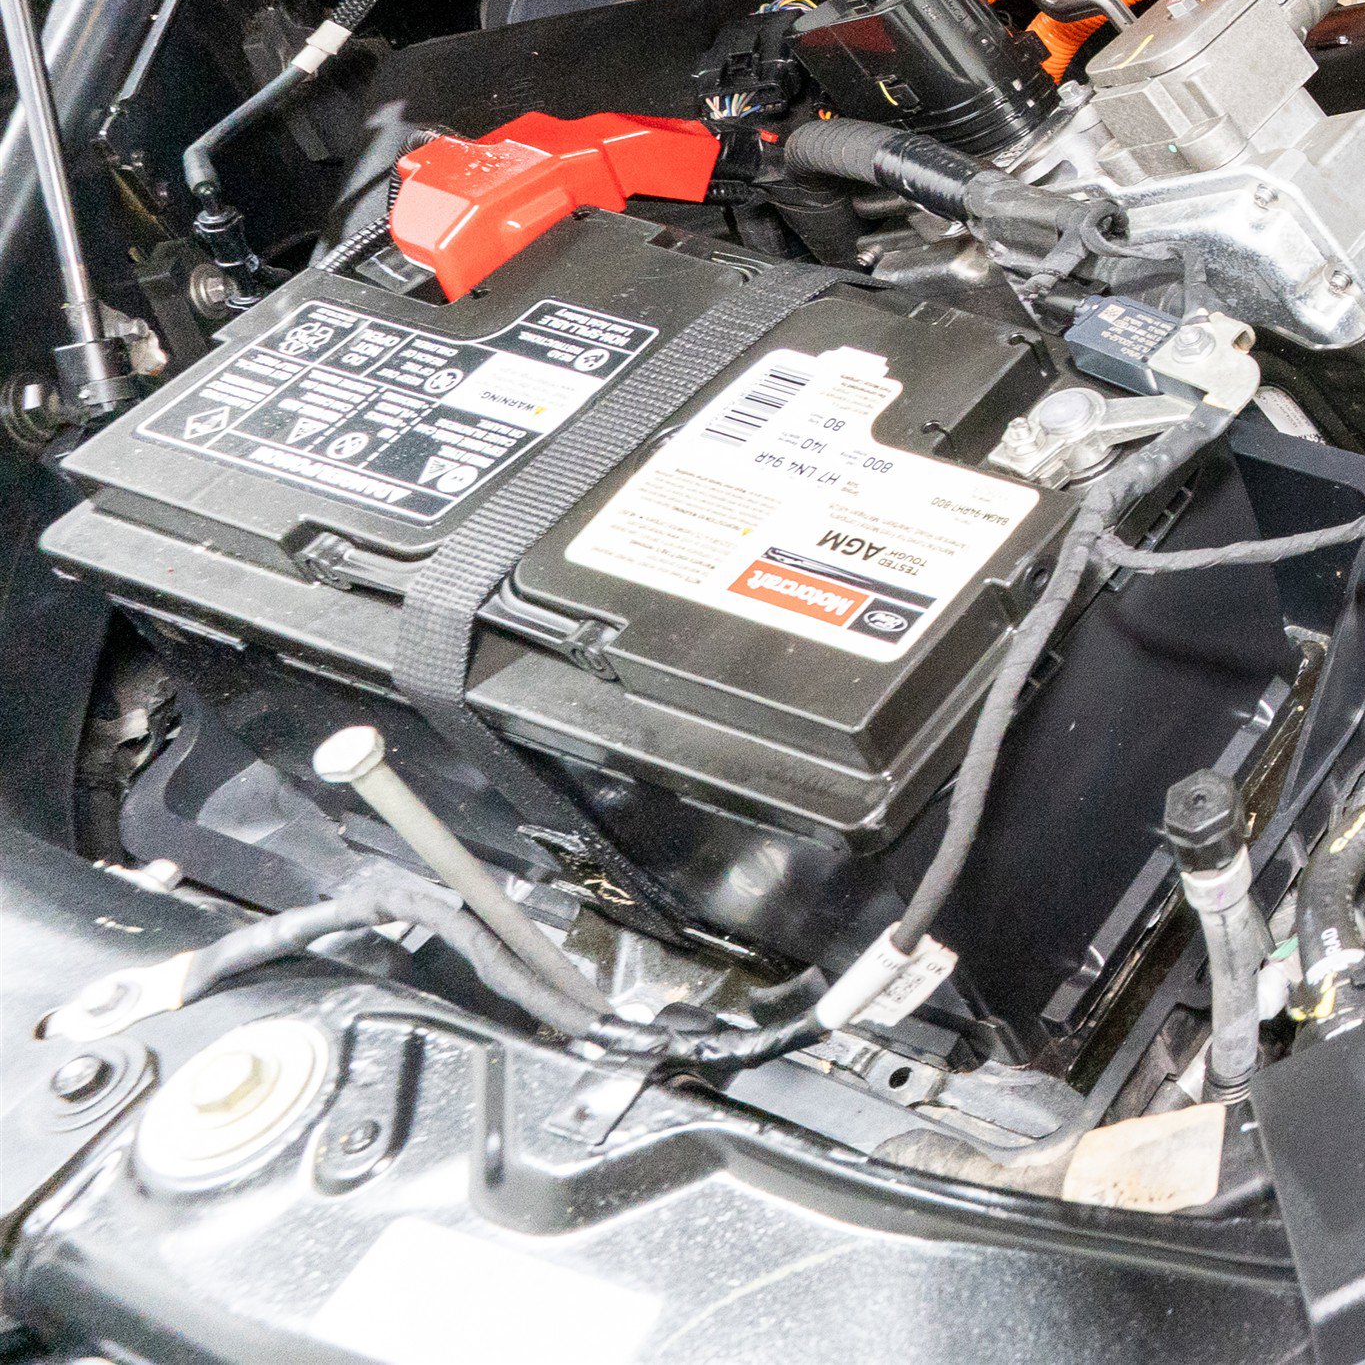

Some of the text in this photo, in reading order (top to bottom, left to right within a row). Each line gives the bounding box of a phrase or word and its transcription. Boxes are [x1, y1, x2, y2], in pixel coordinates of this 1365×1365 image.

[534, 315, 632, 345] NON-SPILLABLE
[348, 340, 385, 356] NOT
[339, 352, 368, 365] DO
[822, 416, 846, 431] 80
[799, 437, 827, 453] 140
[753, 450, 841, 485] H7 LN4 94R
[861, 455, 894, 473] 800
[816, 529, 887, 564] AGM
[878, 557, 921, 576] TESTED
[888, 549, 928, 567] TOUGH
[746, 568, 855, 617] Motorcraft
[868, 612, 904, 631] Ford
